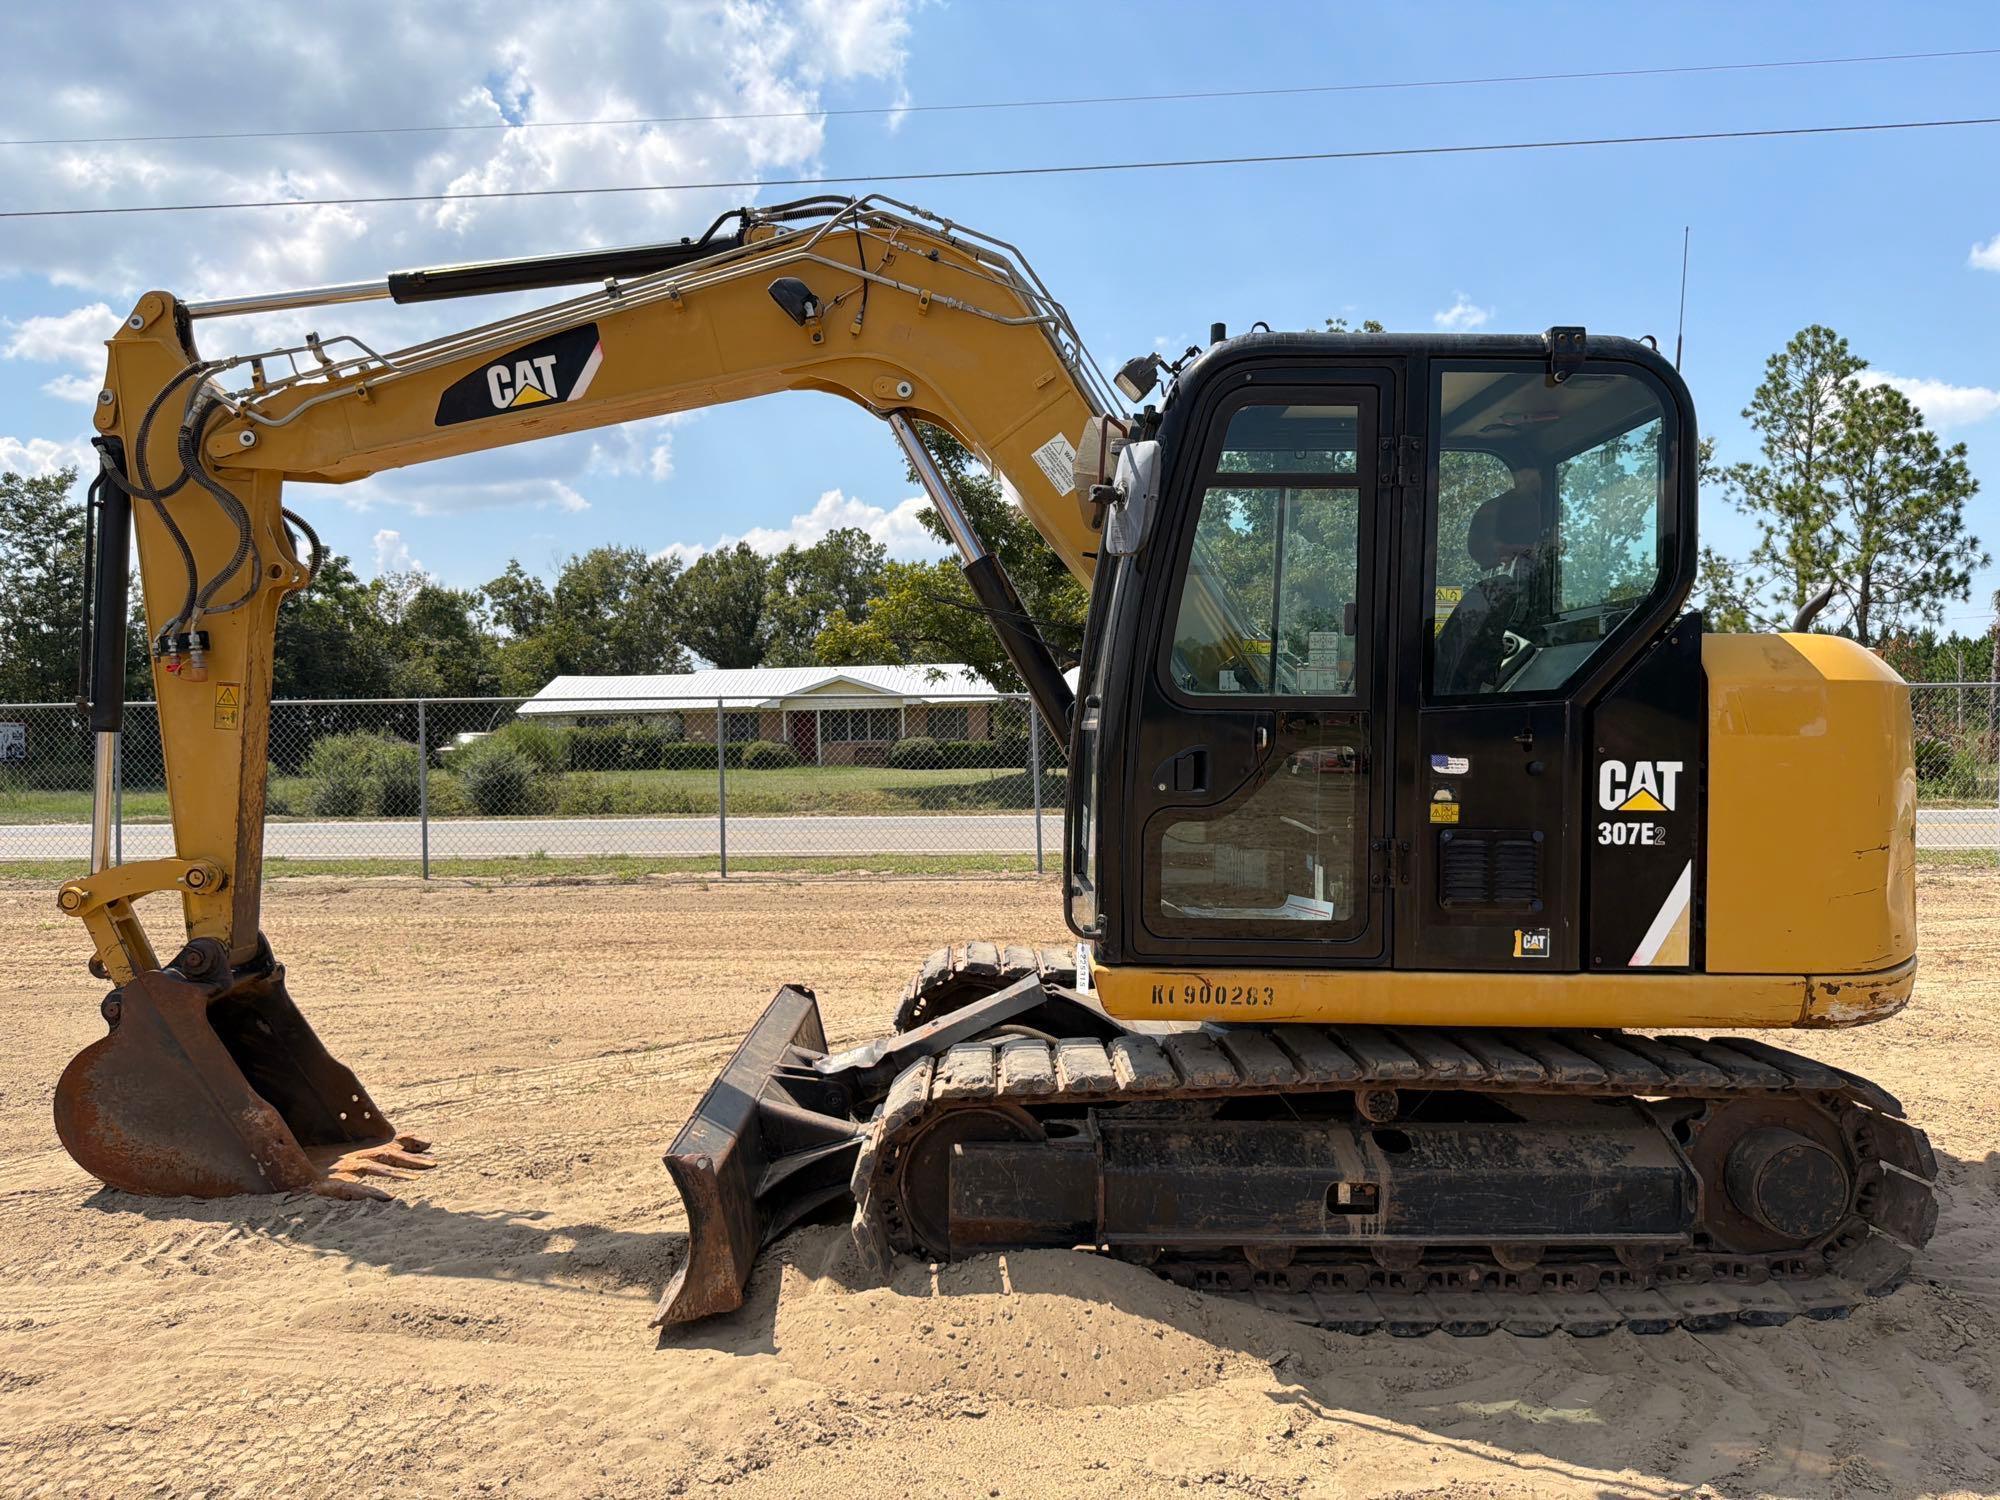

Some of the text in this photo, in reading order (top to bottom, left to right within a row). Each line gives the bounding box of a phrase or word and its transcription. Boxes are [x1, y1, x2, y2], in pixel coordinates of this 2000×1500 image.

[486, 354, 557, 409] CAT
[1599, 760, 1683, 811] CAT
[1598, 822, 1666, 845] 307E2
[1523, 934, 1546, 949] CAT
